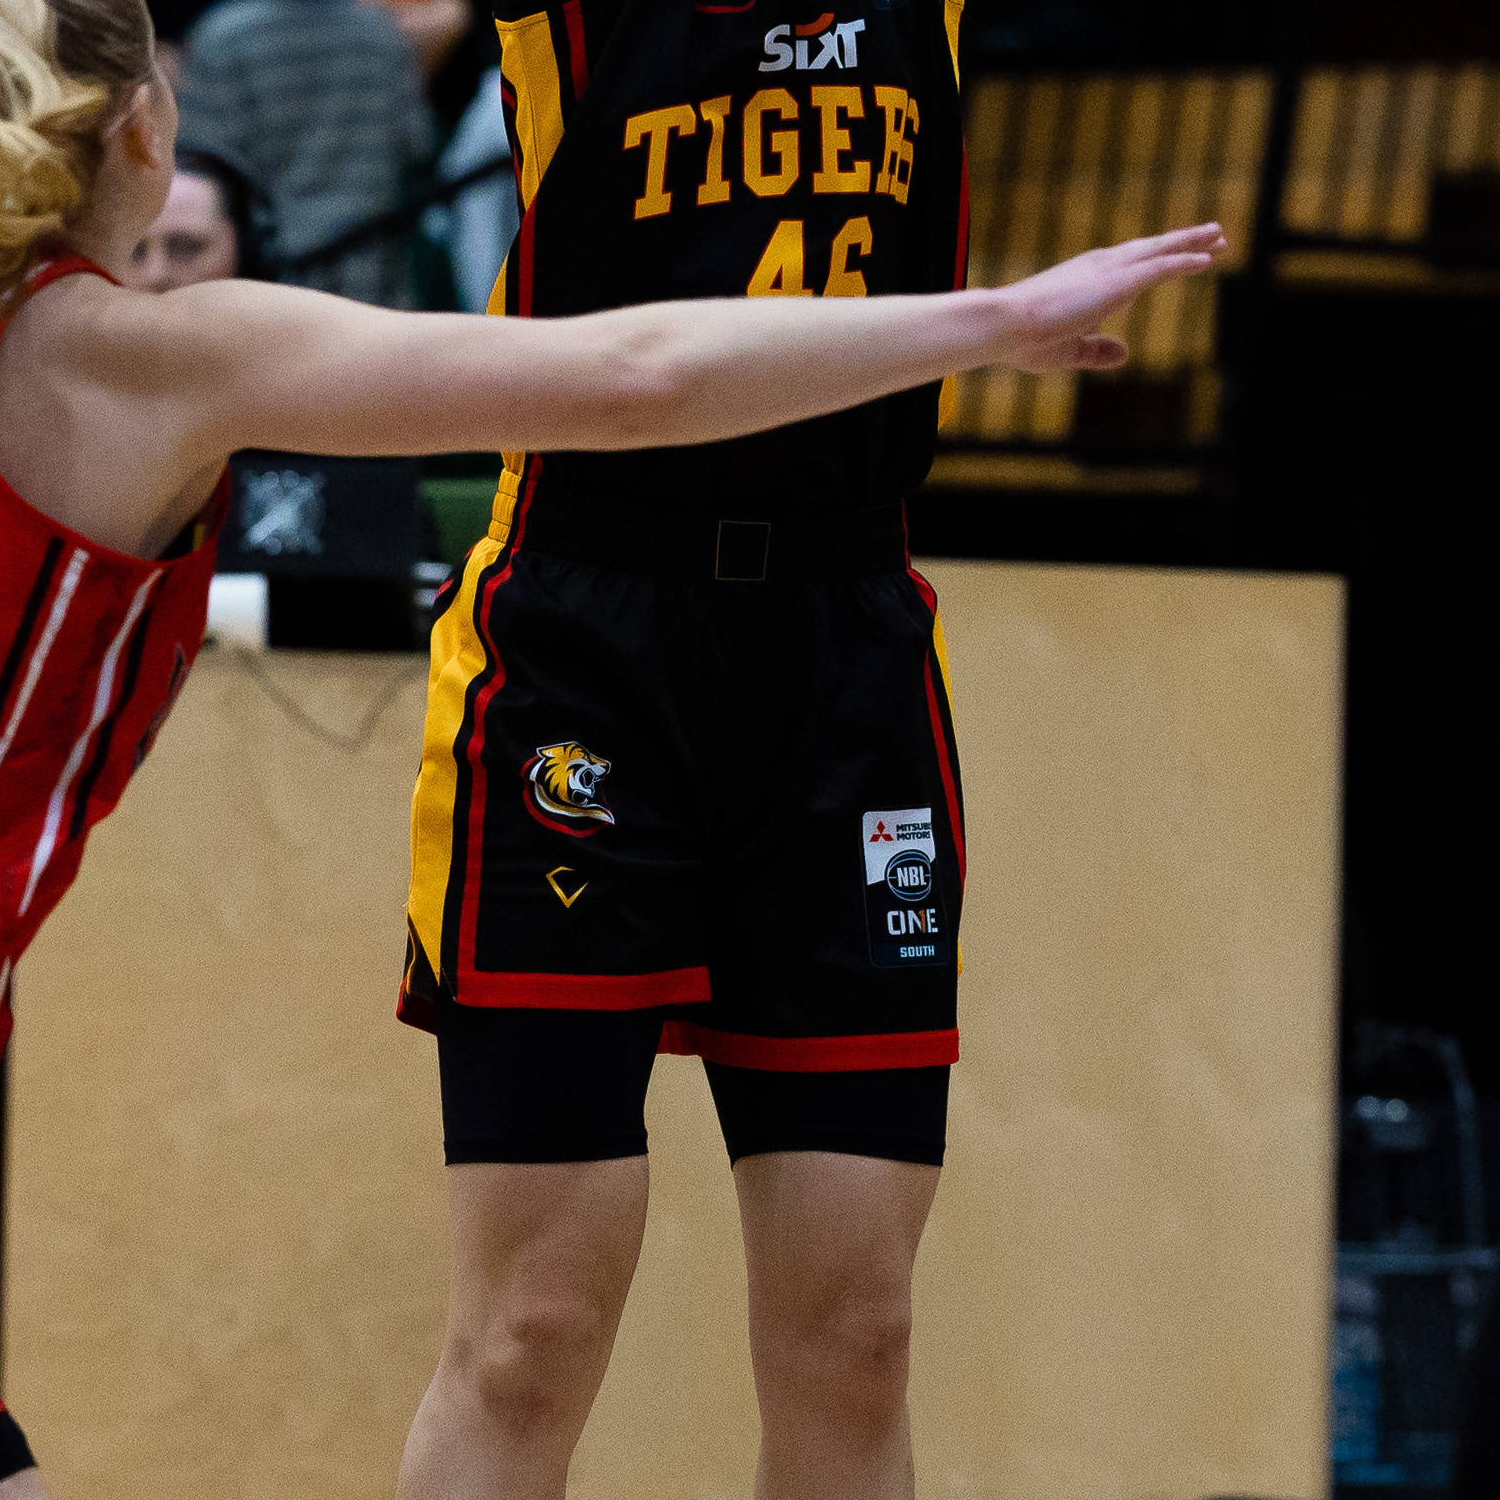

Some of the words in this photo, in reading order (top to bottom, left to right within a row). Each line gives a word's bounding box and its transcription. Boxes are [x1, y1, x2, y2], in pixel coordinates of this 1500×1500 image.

[896, 822, 931, 832] MITSUB
[896, 866, 927, 887] NBL
[887, 908, 938, 935] ONE
[900, 945, 935, 958] SOUTH
